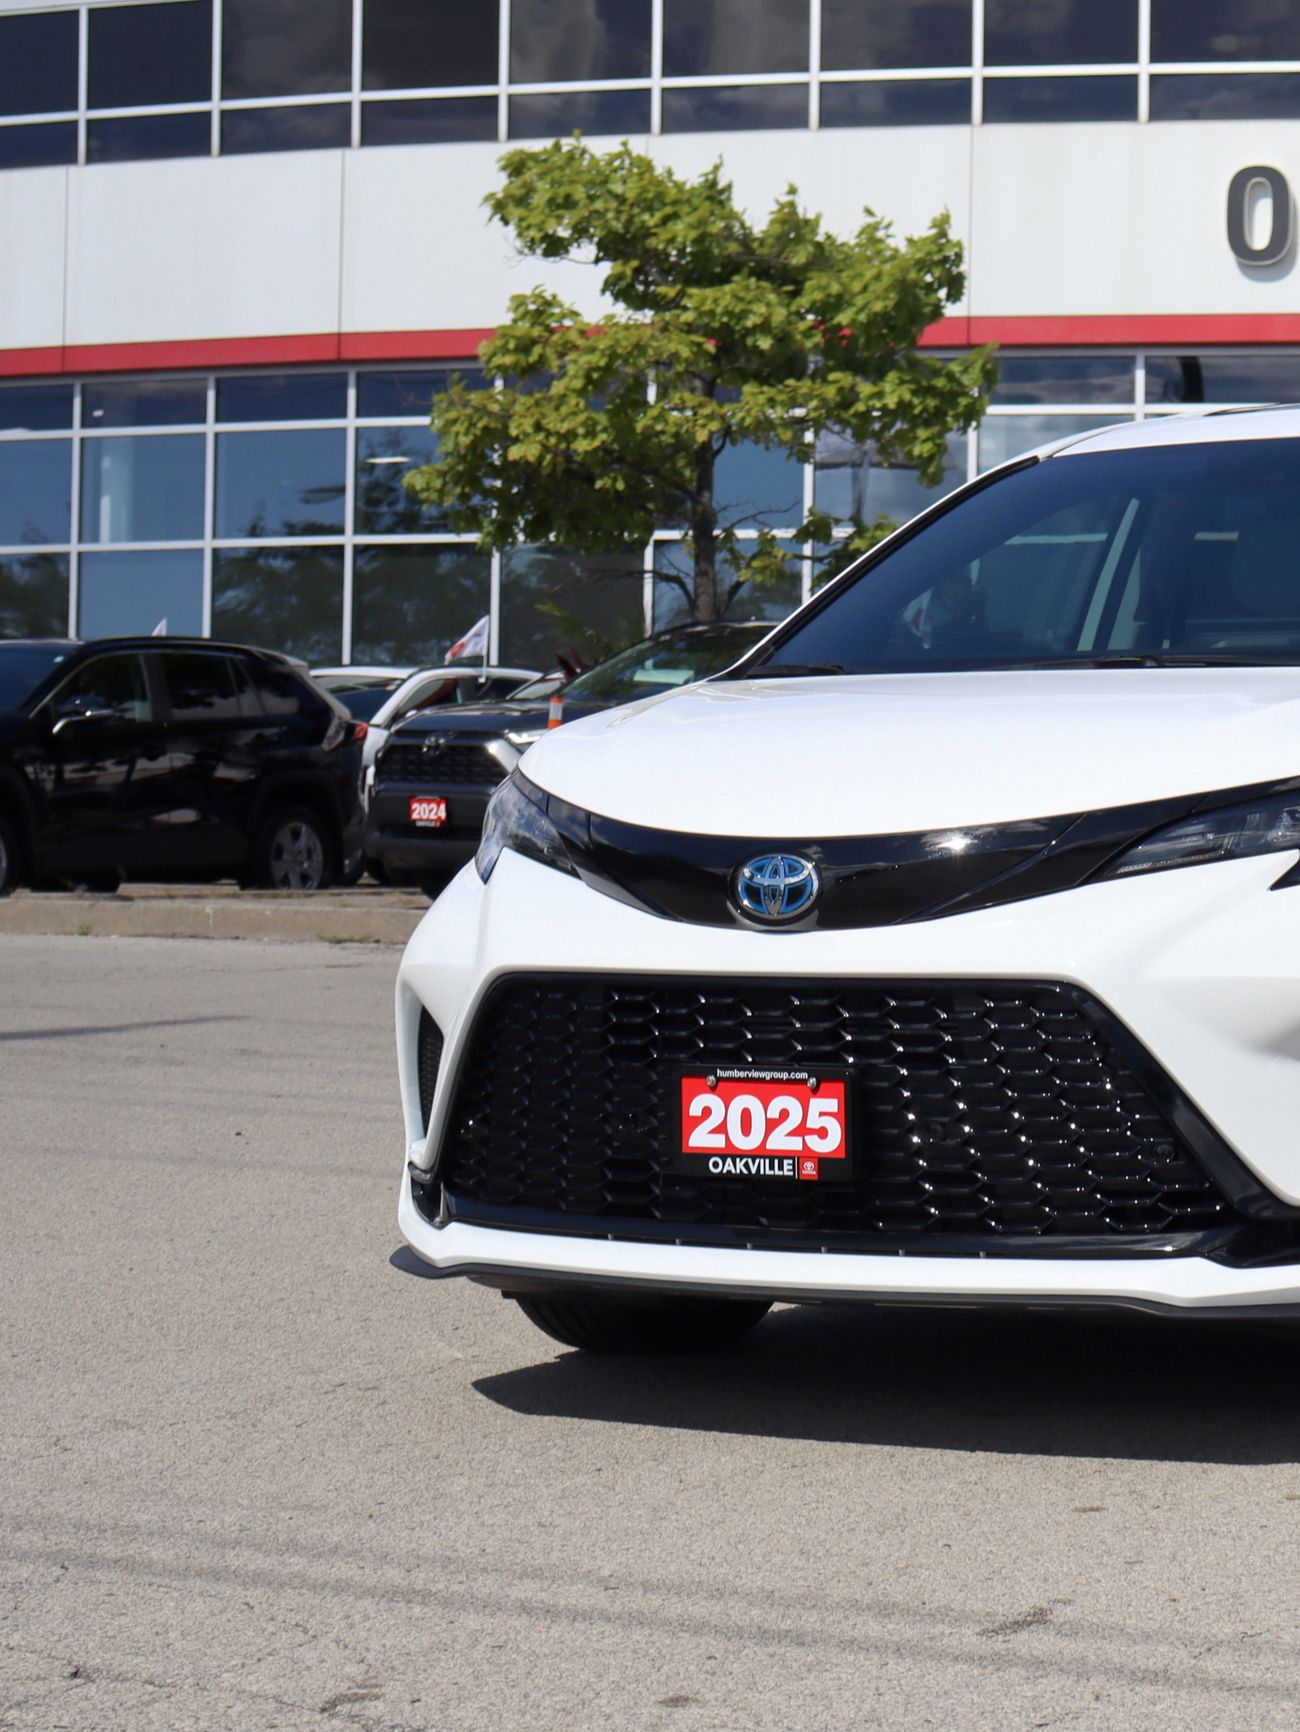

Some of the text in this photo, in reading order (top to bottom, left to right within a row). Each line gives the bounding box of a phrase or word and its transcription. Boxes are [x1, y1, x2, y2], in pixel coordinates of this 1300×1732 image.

[411, 802, 447, 820] 2024
[716, 1068, 809, 1081] humberviewgroup.com
[688, 1093, 842, 1153] 2025
[708, 1156, 794, 1176] OAKVILLE
